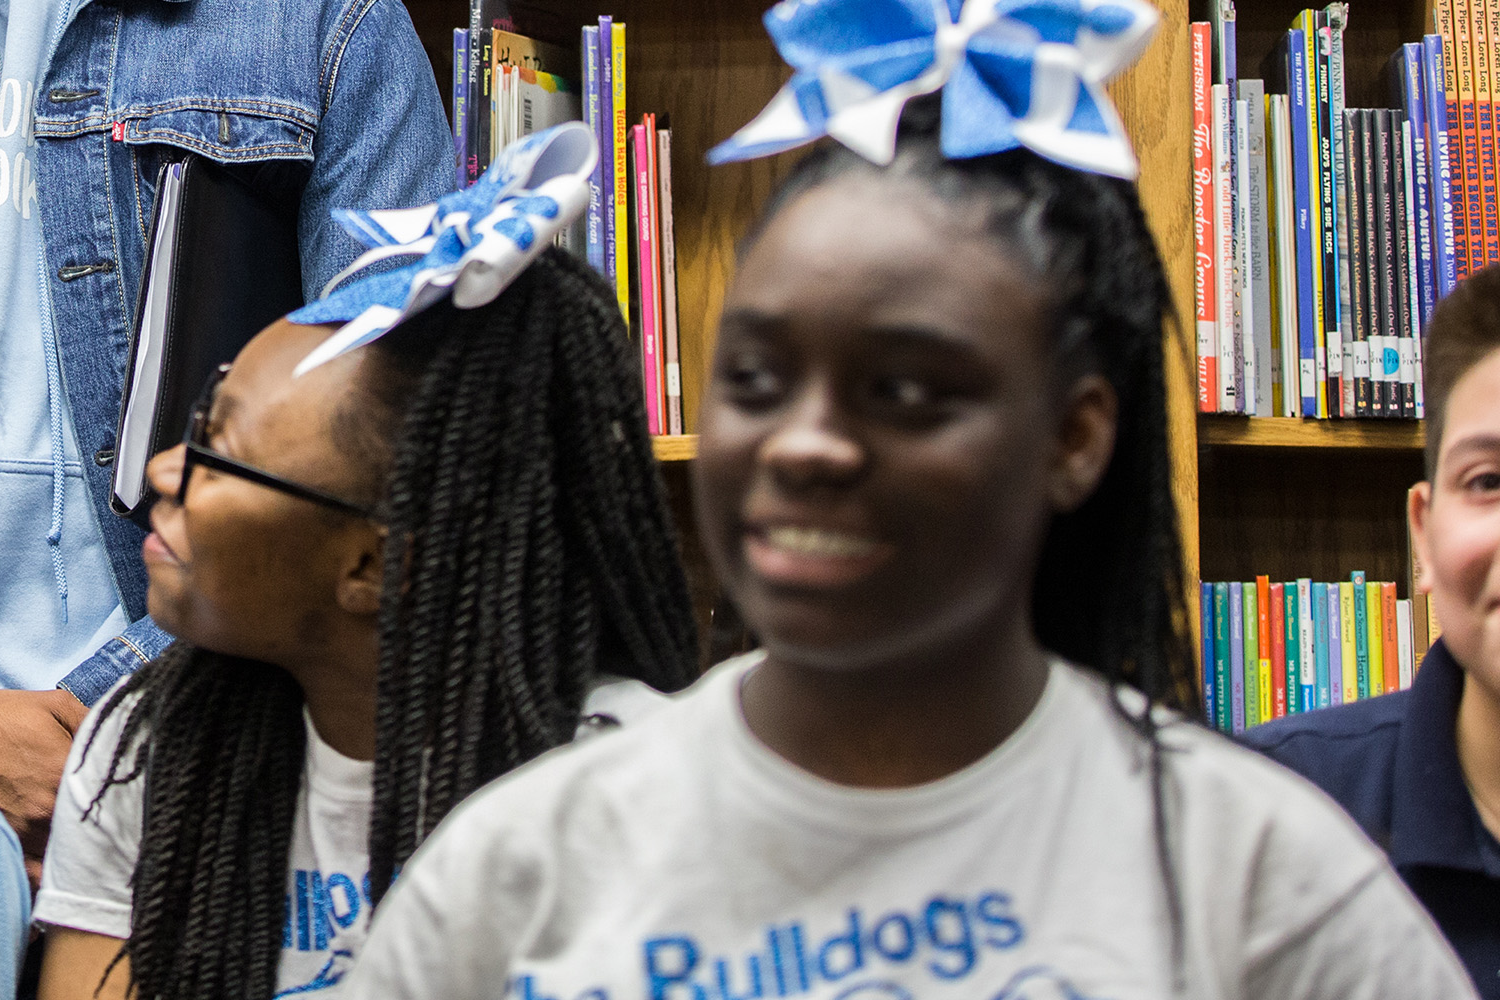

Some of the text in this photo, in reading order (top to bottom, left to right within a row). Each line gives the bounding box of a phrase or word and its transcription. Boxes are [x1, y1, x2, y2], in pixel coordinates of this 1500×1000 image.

[1442, 10, 1450, 34] Piper
[1458, 10, 1467, 34] Piper
[1476, 10, 1484, 35] Piper
[1491, 11, 1500, 36] Piper
[469, 8, 481, 83] Massie Kellogg
[1444, 40, 1452, 66] Loren
[1461, 40, 1469, 66] Loren
[1478, 41, 1486, 67] Loren
[482, 45, 491, 96] Long Shannon
[1193, 33, 1204, 112] PETERSHAM
[1295, 67, 1303, 107] PAPERBOY
[1435, 54, 1443, 92] Pinkwater
[1446, 69, 1454, 92] Long
[1463, 69, 1471, 92] Long
[1479, 70, 1488, 93] Long
[456, 48, 466, 137] London Rodanas
[616, 52, 627, 205] Wonder Flutes Have Holes
[1463, 102, 1475, 130] THE
[1480, 103, 1491, 130] THE
[588, 45, 601, 244] London Little Swan
[1193, 123, 1210, 158] The
[1438, 131, 1450, 178] IRVING
[1465, 135, 1478, 181] LITTLE
[1320, 64, 1333, 254] PINKNEY JOJO'S FLYING SIDE KICK
[1482, 136, 1495, 182] LITTLE
[1194, 168, 1211, 246] Rooster
[1221, 178, 1230, 202] Cold
[1250, 185, 1260, 222] STORM
[1222, 206, 1232, 233] Little
[1452, 185, 1465, 236] ENGINE
[1468, 185, 1482, 236] ENGINE
[1484, 186, 1498, 237] ENGINE
[1252, 252, 1262, 281] BARN
[1422, 264, 1431, 283] Two
[1446, 258, 1455, 277] Two
[1456, 240, 1467, 275] THAT
[1401, 268, 1409, 305] Celebration
[1424, 285, 1433, 303] Bad
[1224, 299, 1234, 327] Duck
[1357, 655, 1366, 684] Henry
[643, 890, 1024, 1000] Bulldogs
